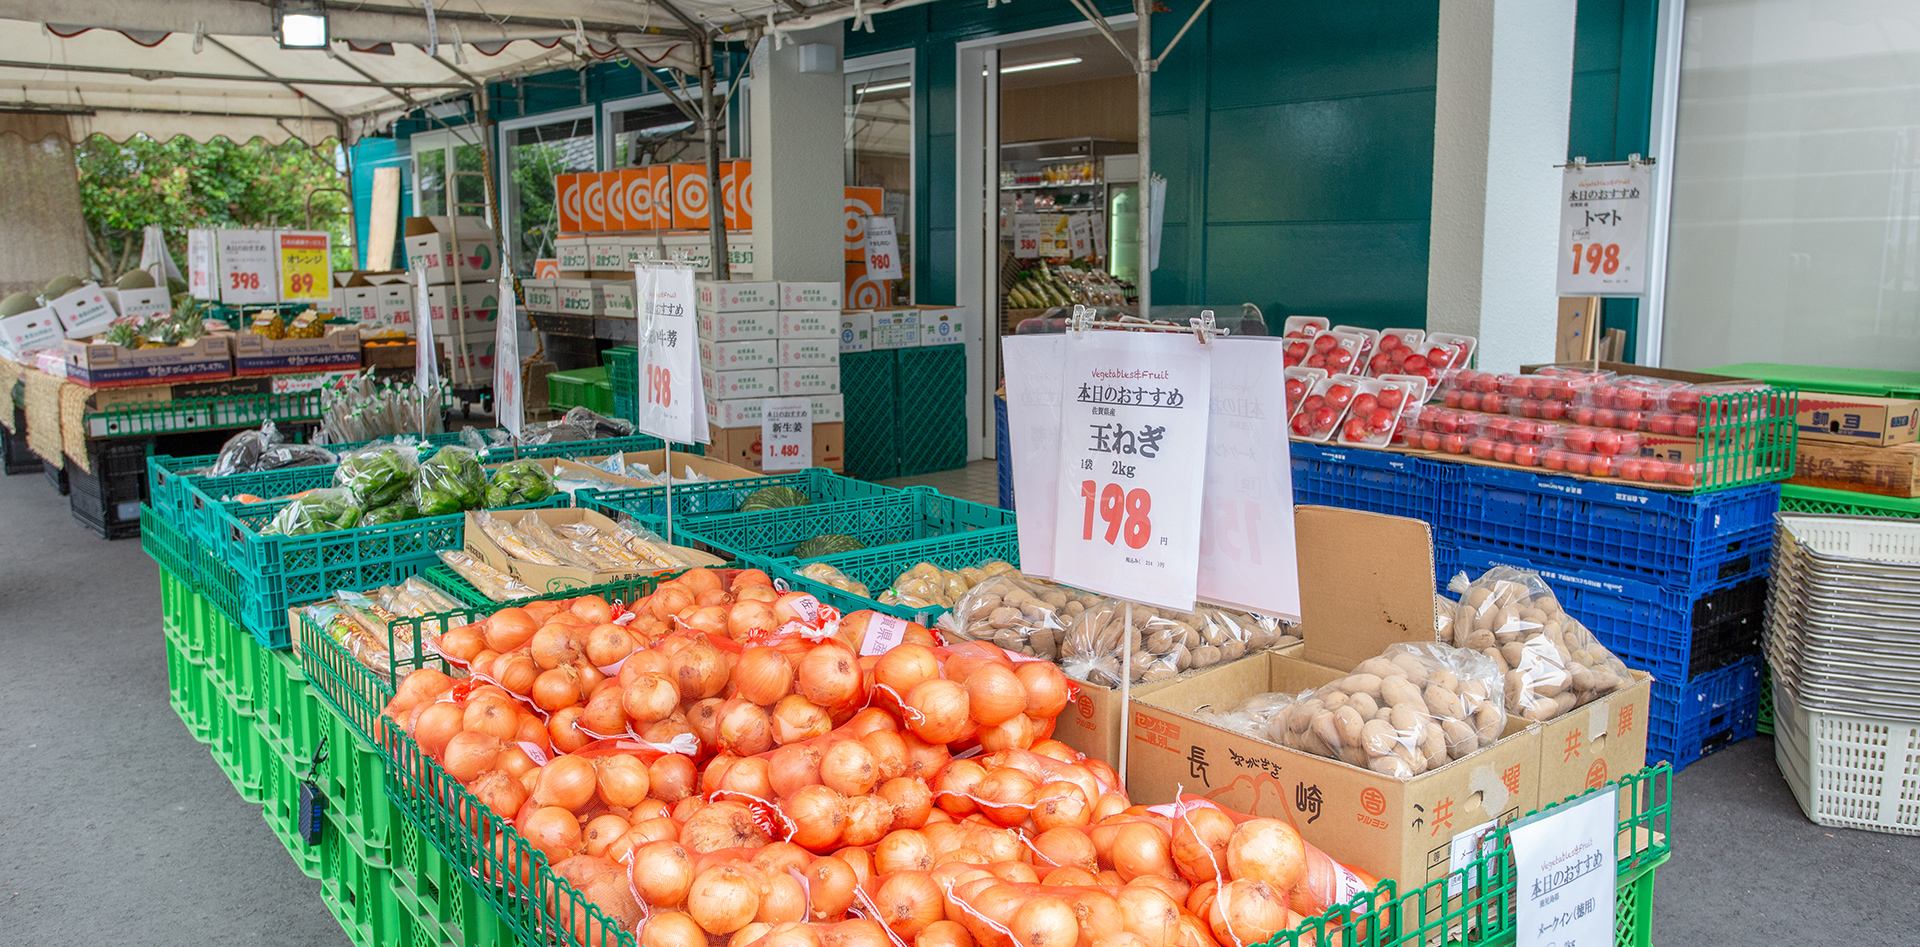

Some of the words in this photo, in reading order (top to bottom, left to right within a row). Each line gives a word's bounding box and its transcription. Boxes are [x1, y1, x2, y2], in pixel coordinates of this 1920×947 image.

[1569, 187, 1640, 200] 本日のおすすめ
[1585, 209, 1622, 227] トマト
[1020, 239, 1037, 250] 380
[287, 255, 323, 265] オレンジ
[871, 253, 890, 270] 980
[1572, 243, 1620, 275] 198
[230, 272, 260, 290] 398
[291, 273, 313, 293] 89
[1091, 367, 1169, 381] Vegetables&Fruit
[647, 363, 671, 408] 198
[1077, 382, 1184, 407] 本日のおすすめ
[1091, 406, 1116, 417] 佐賀県産
[1088, 423, 1166, 458] 玉ねぎ
[1081, 459, 1093, 470] 1袋
[1111, 460, 1136, 478] 2kg
[1081, 480, 1152, 550] 198
[1160, 536, 1168, 546] 円
[1136, 712, 1180, 739] センサー
[1564, 728, 1582, 764] 共
[1617, 703, 1634, 738] 撰
[1146, 731, 1168, 750] 選別
[1187, 746, 1210, 788] 長
[1229, 748, 1283, 780] ながさき
[1295, 781, 1324, 824] 崎
[1356, 813, 1389, 830] マルヨシ
[1431, 797, 1454, 837] 共
[1541, 838, 1593, 871] Vegetables&Fruit
[1531, 849, 1603, 898] 本日のおすすめ
[1537, 896, 1596, 939] メークイン(徳用)
